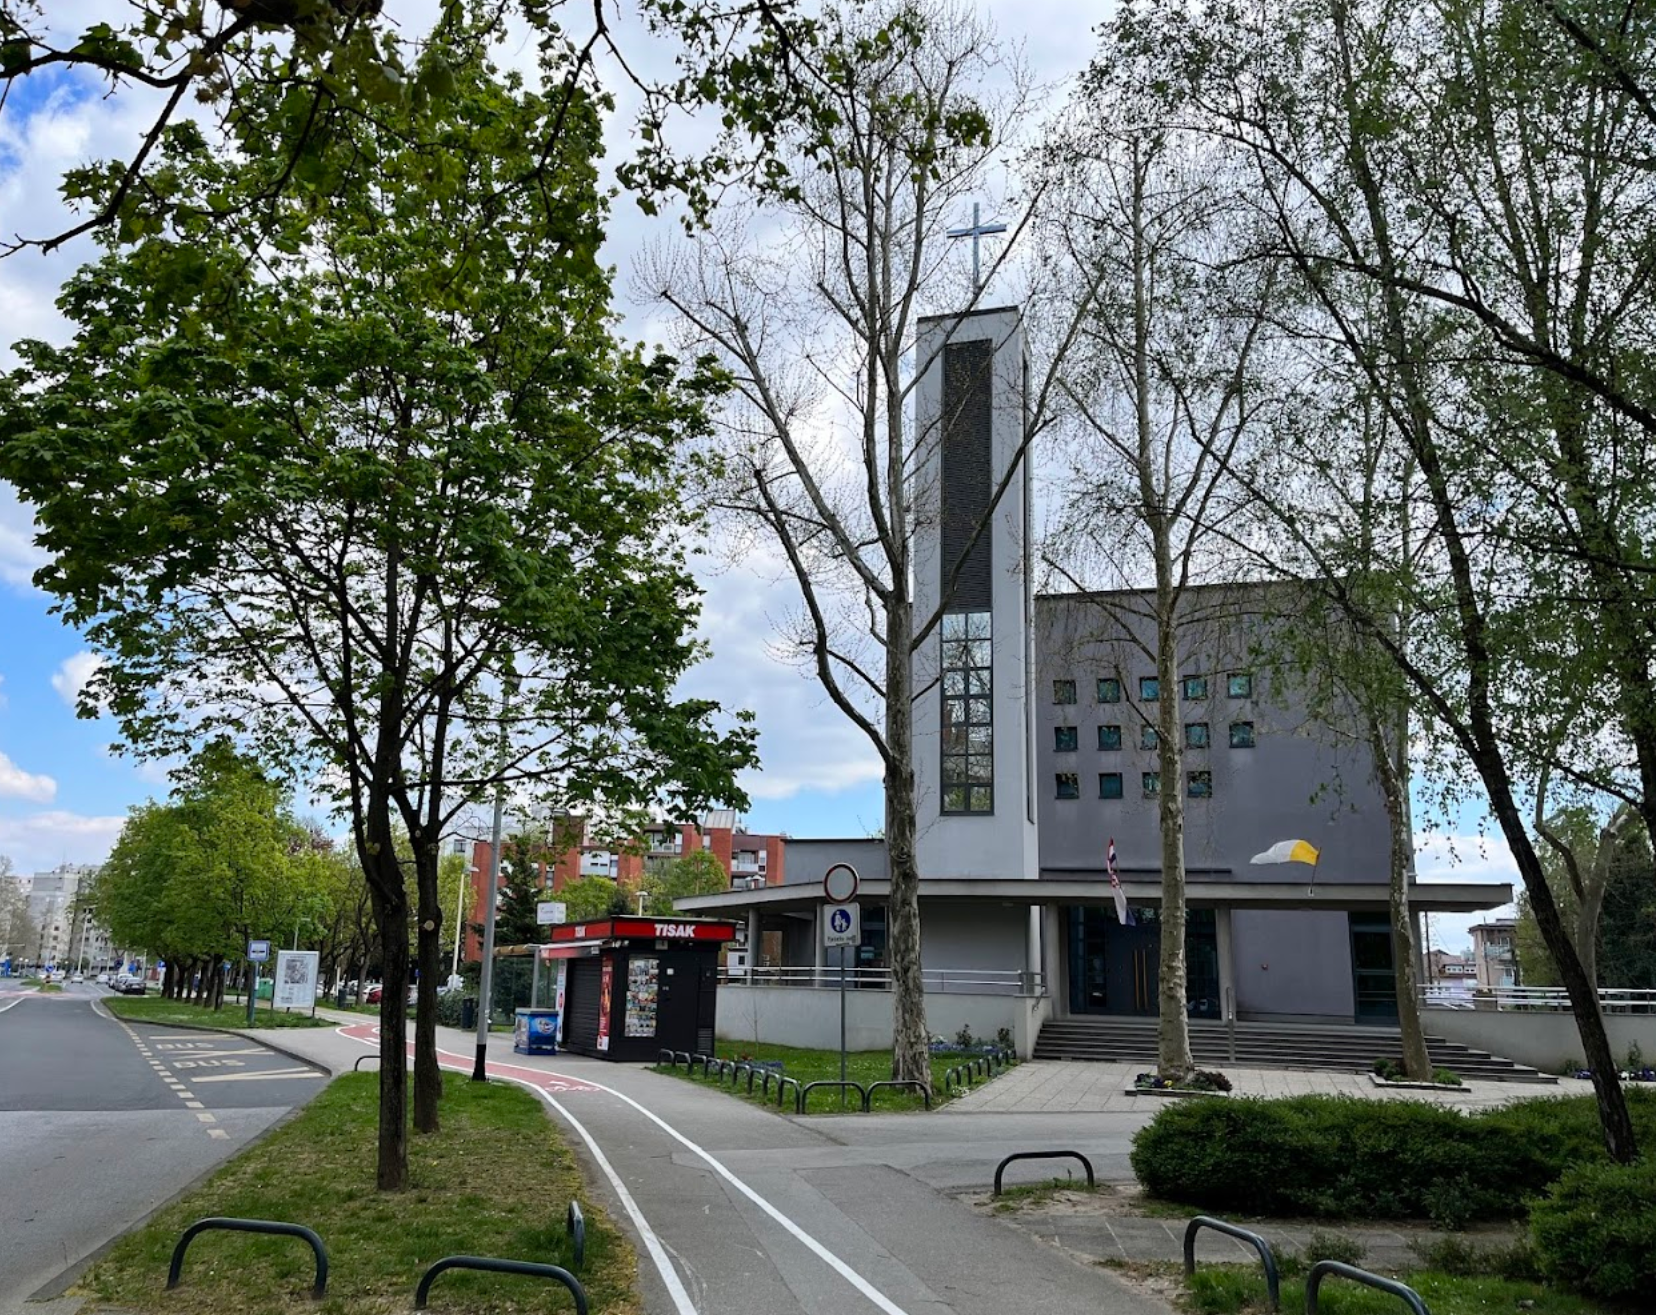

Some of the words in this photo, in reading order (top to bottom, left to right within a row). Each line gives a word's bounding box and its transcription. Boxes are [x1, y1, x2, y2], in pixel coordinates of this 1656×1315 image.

[654, 923, 695, 937] TISAK
[156, 1042, 214, 1050] BUS
[173, 1060, 245, 1069] BUS
